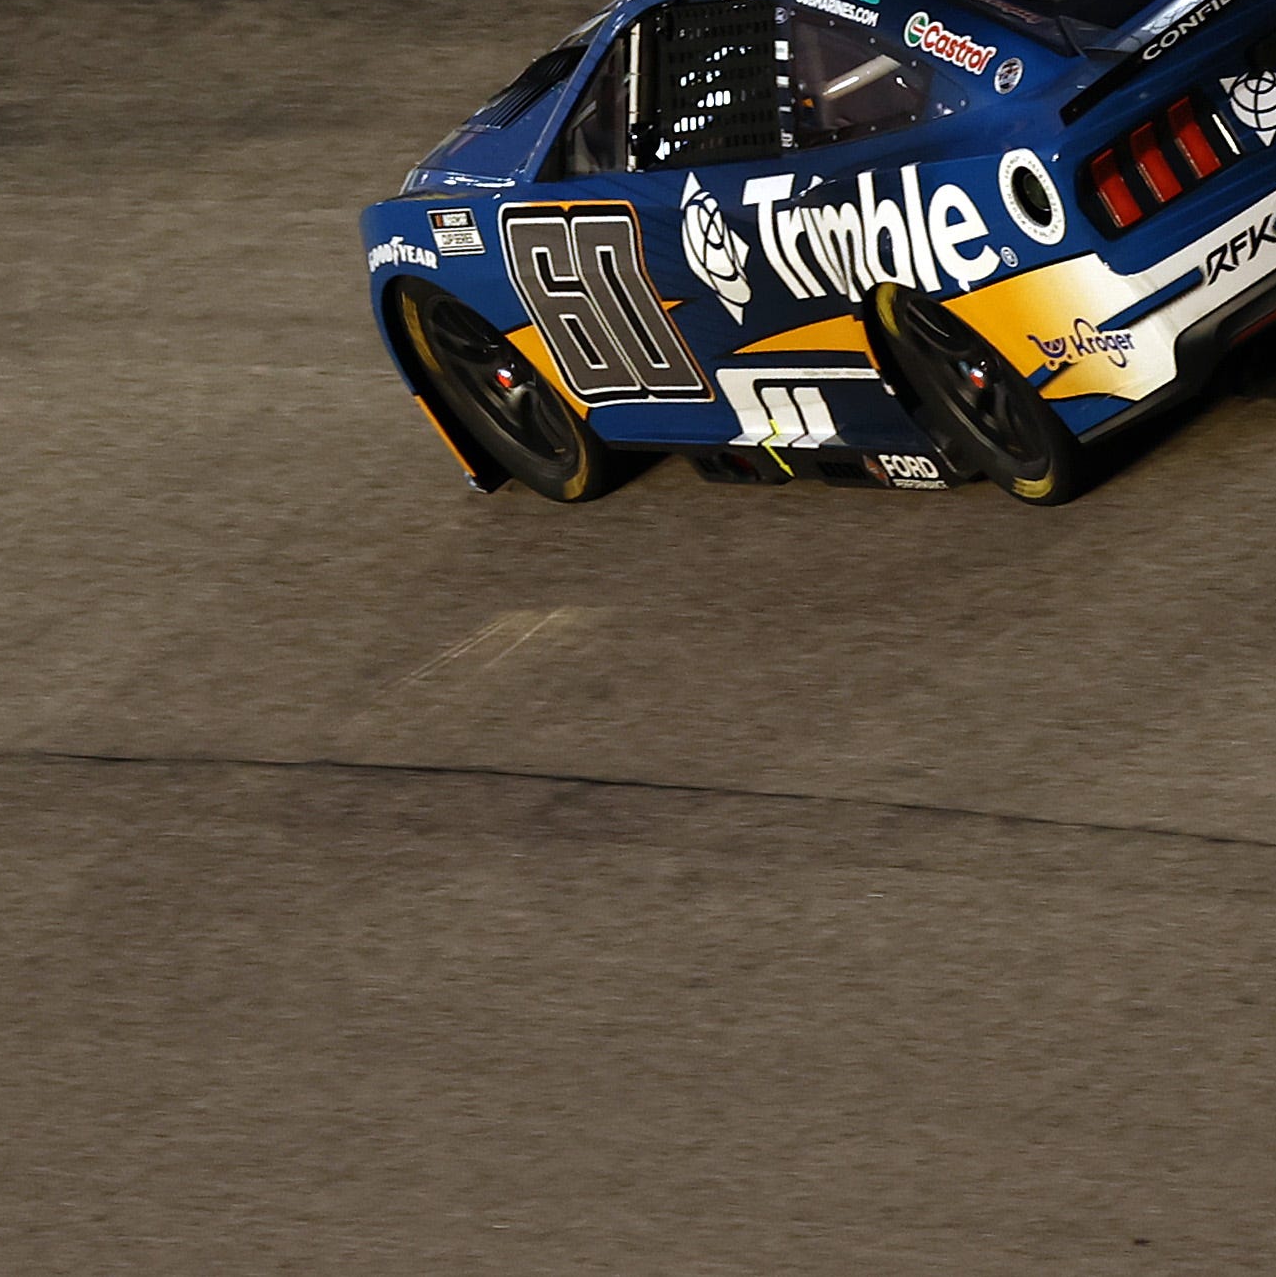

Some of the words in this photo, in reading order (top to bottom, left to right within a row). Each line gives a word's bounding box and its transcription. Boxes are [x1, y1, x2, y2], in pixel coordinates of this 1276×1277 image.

[923, 22, 998, 75] Castrol
[742, 161, 1001, 303] Trimble
[499, 200, 716, 408] 60
[1073, 318, 1135, 368] Kroger
[878, 454, 940, 479] FORD
